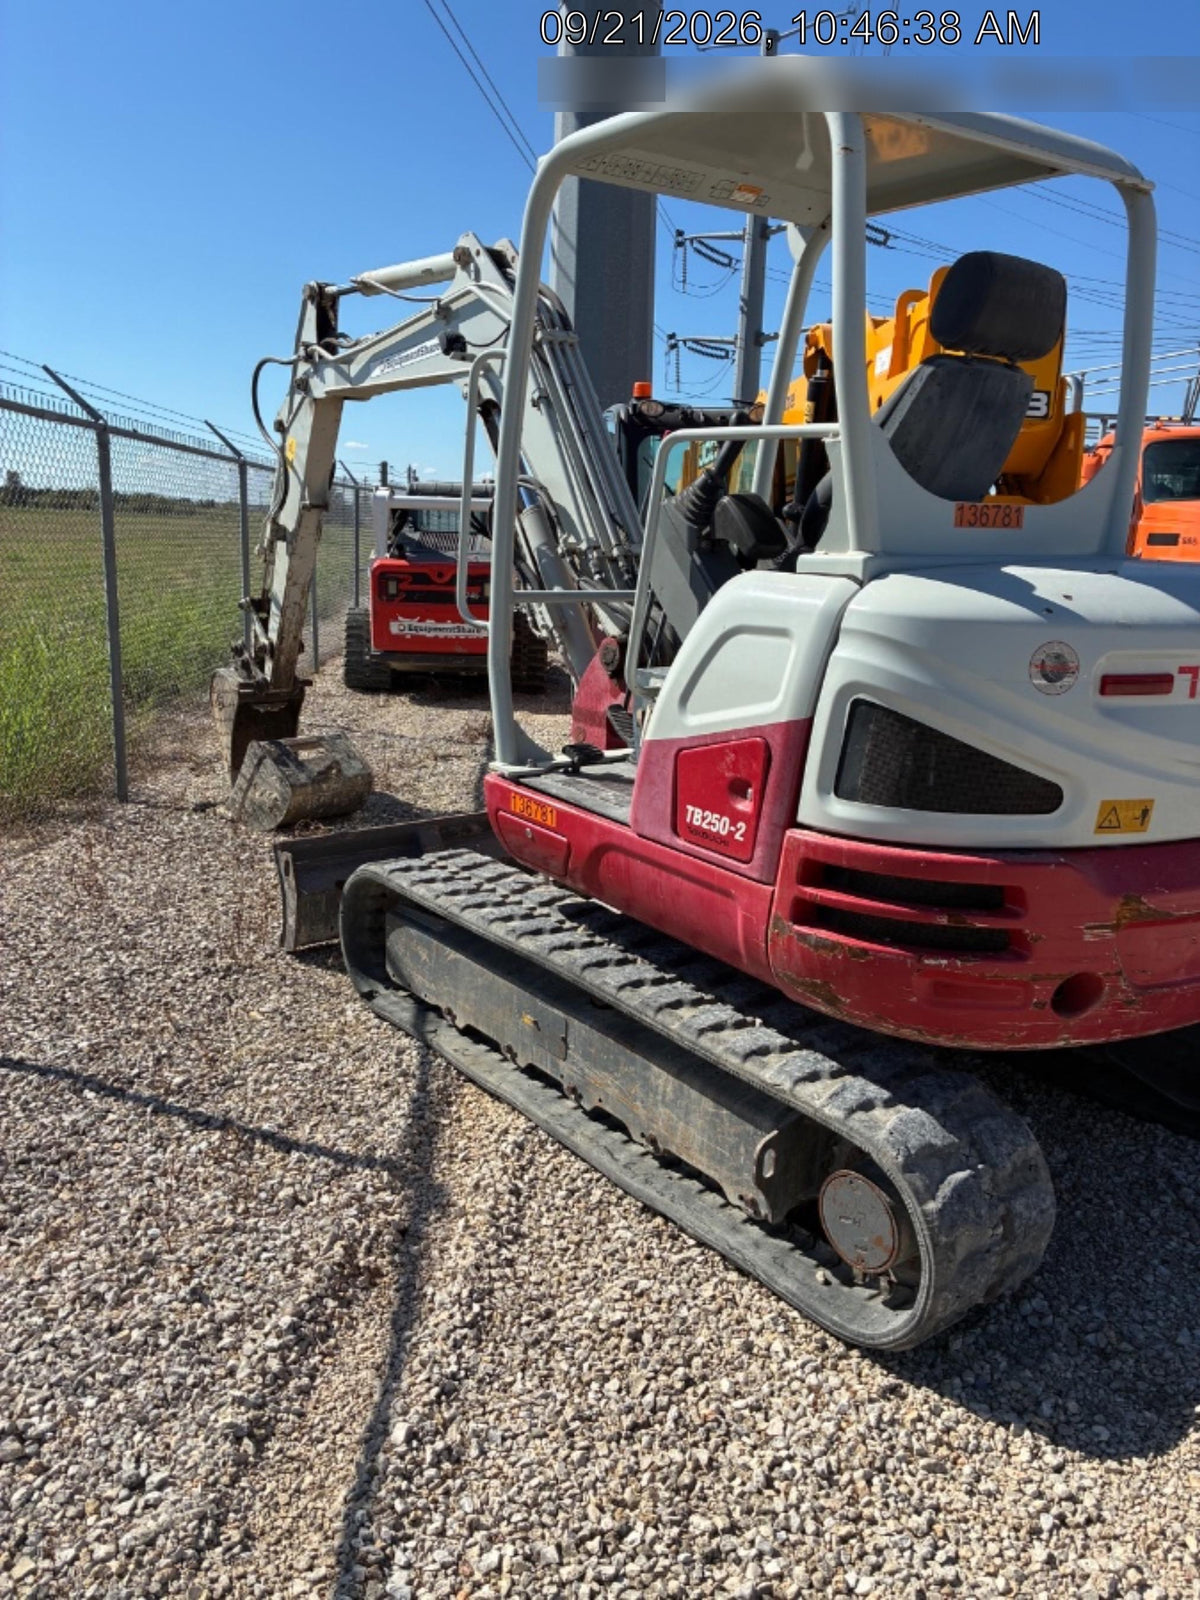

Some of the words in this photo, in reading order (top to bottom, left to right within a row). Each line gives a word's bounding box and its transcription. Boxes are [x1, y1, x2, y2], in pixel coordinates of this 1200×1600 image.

[956, 503, 1022, 527] 136781
[512, 795, 554, 825] 136781
[685, 804, 747, 842] TB250-2
